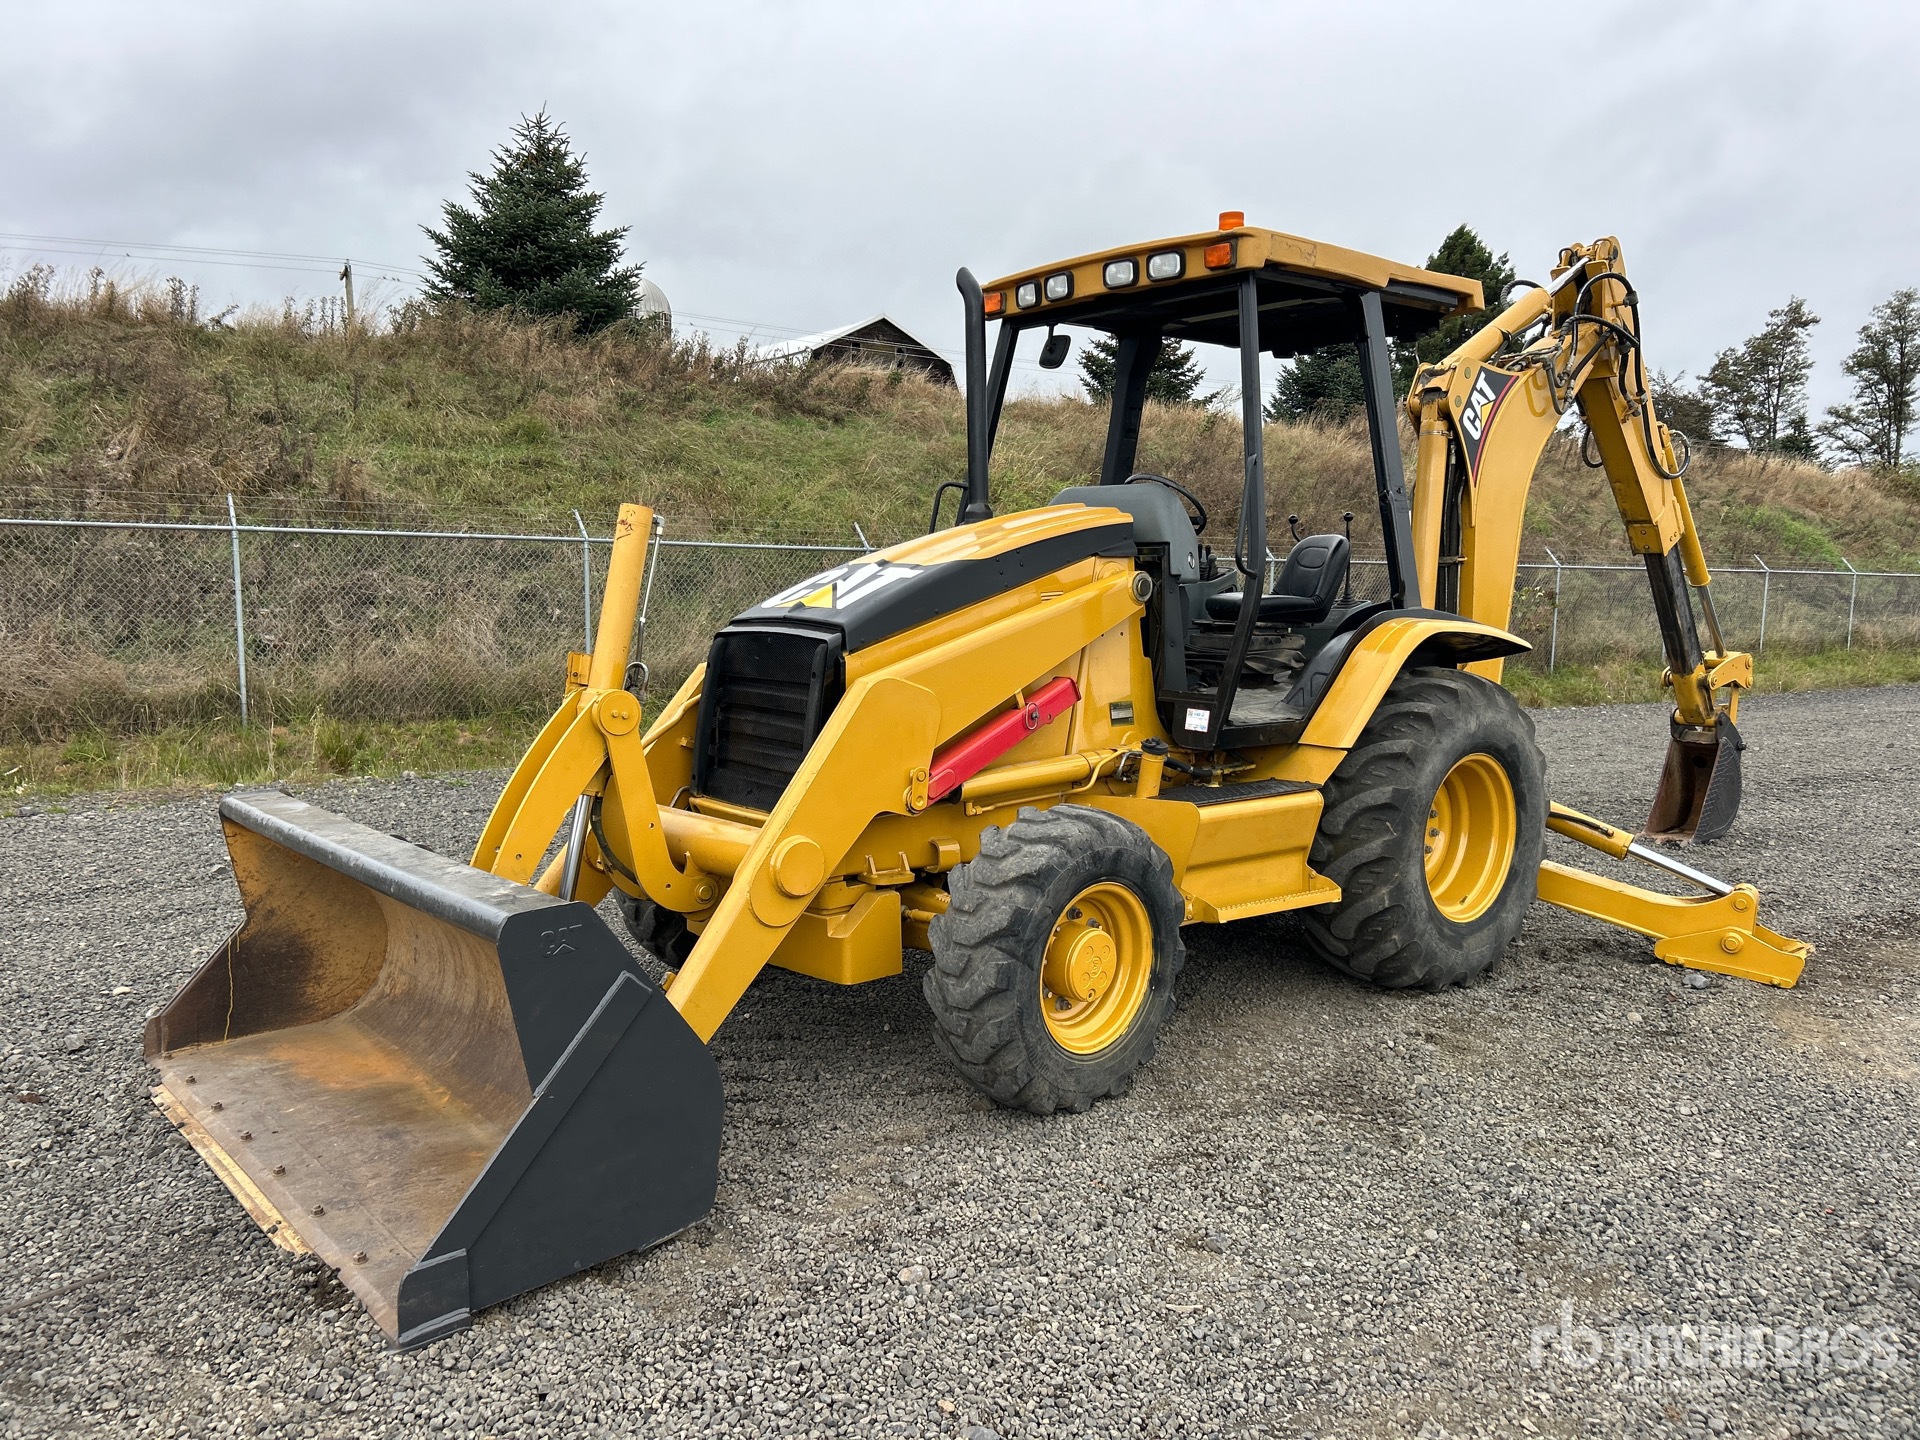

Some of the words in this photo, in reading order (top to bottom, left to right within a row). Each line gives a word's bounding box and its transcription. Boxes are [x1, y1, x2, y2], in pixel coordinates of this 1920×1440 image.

[1463, 371, 1496, 440] CAT
[760, 564, 924, 609] CAT
[540, 924, 582, 957] CAT
